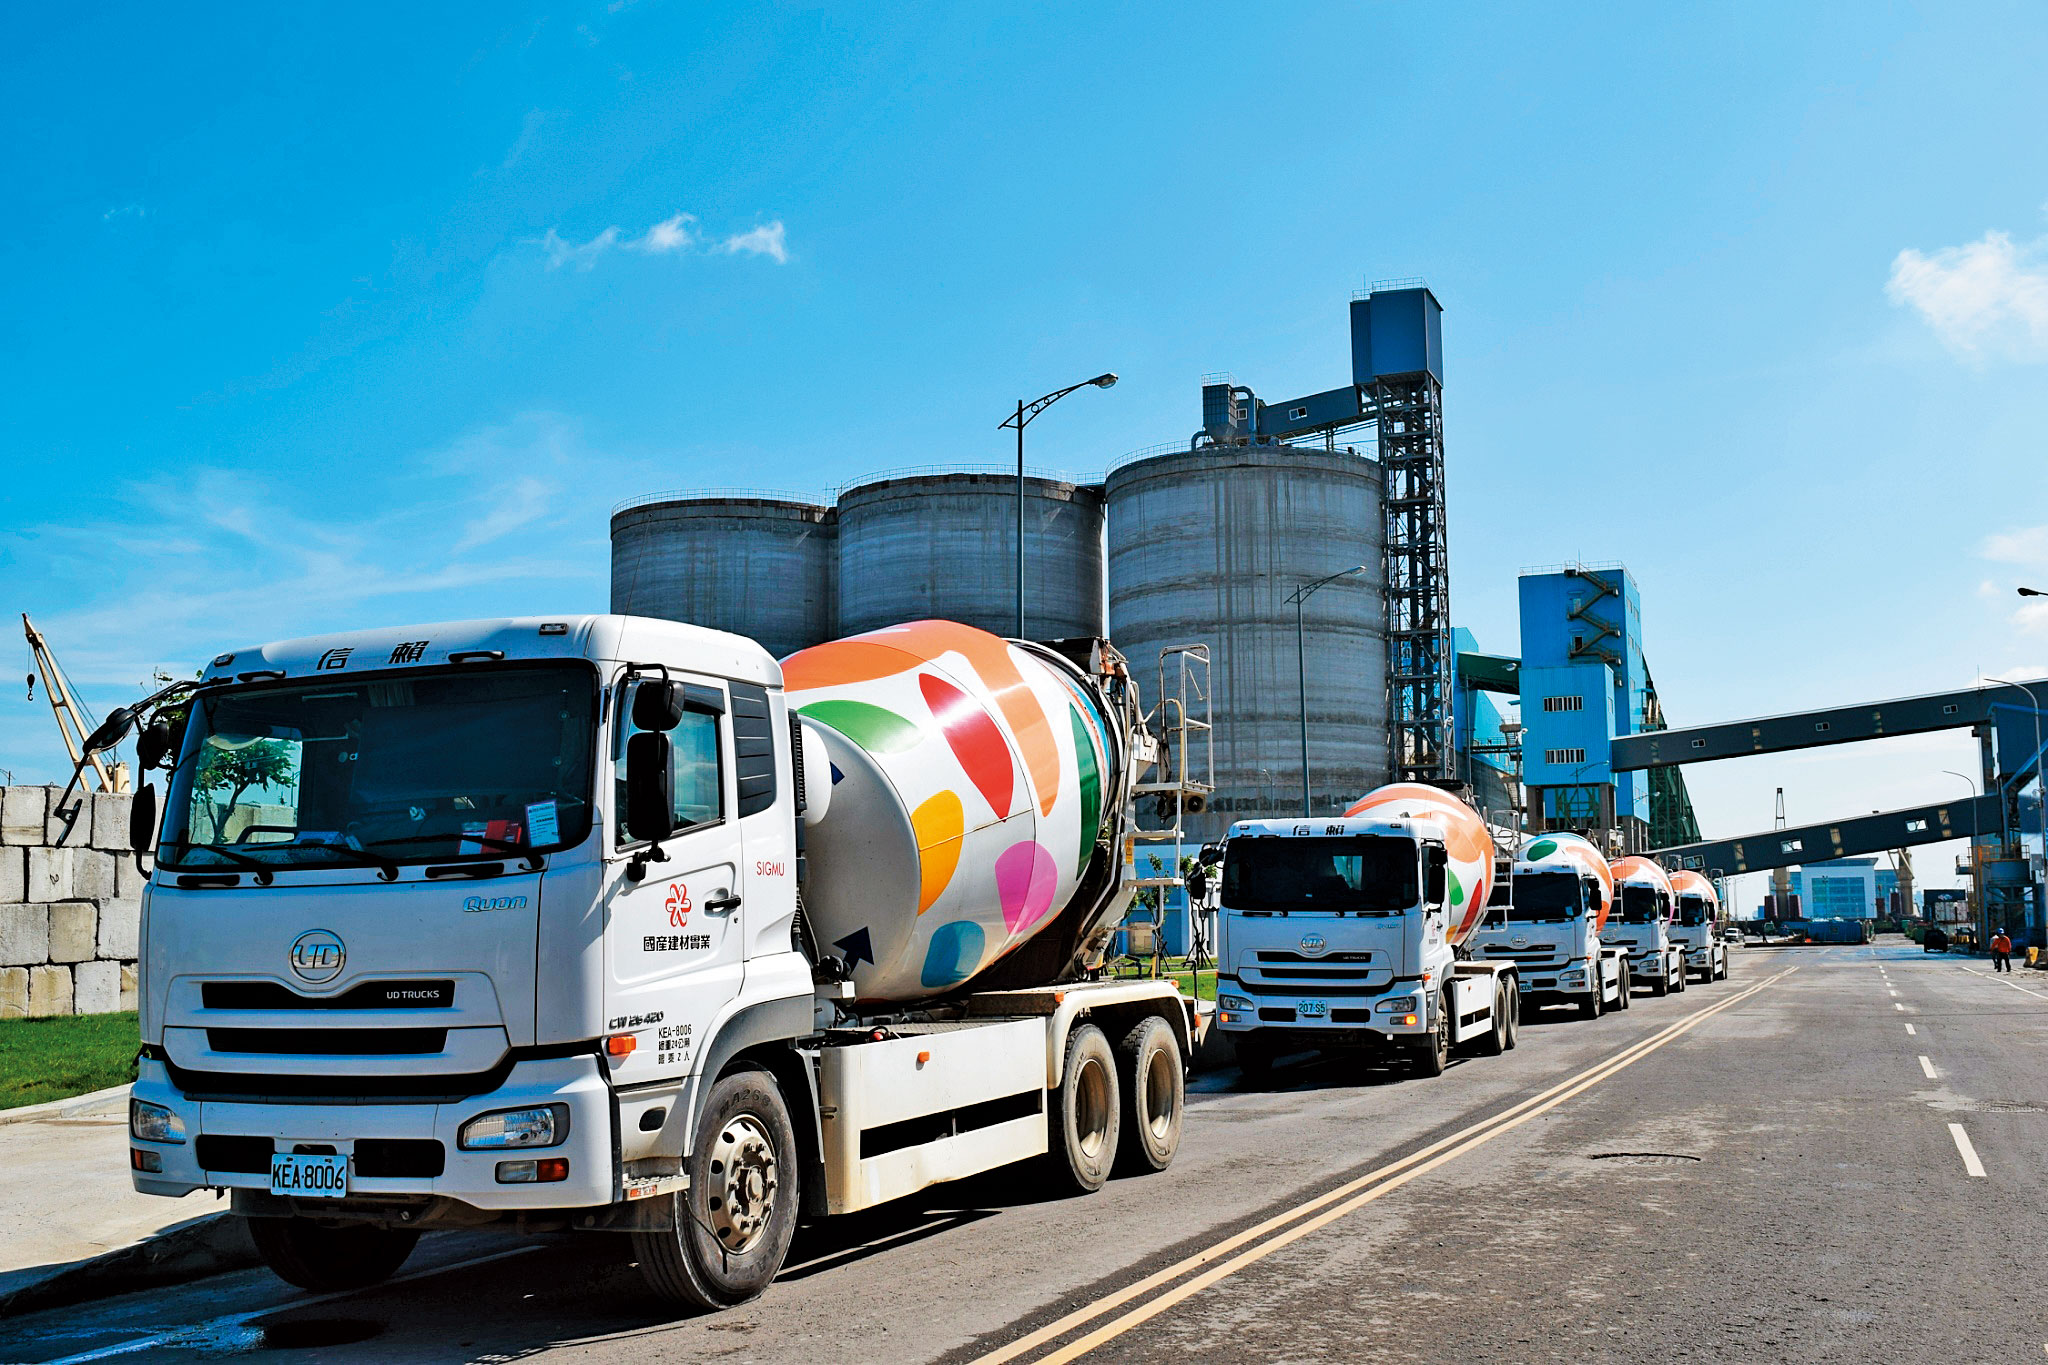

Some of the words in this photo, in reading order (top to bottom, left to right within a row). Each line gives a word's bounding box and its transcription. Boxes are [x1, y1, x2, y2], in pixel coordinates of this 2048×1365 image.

[756, 861, 785, 877] SIGMU
[463, 895, 528, 913] Quon
[292, 943, 340, 970] UD
[386, 990, 400, 999] UD
[402, 989, 440, 999] TRUCKS
[658, 1023, 692, 1039] KEA-8006
